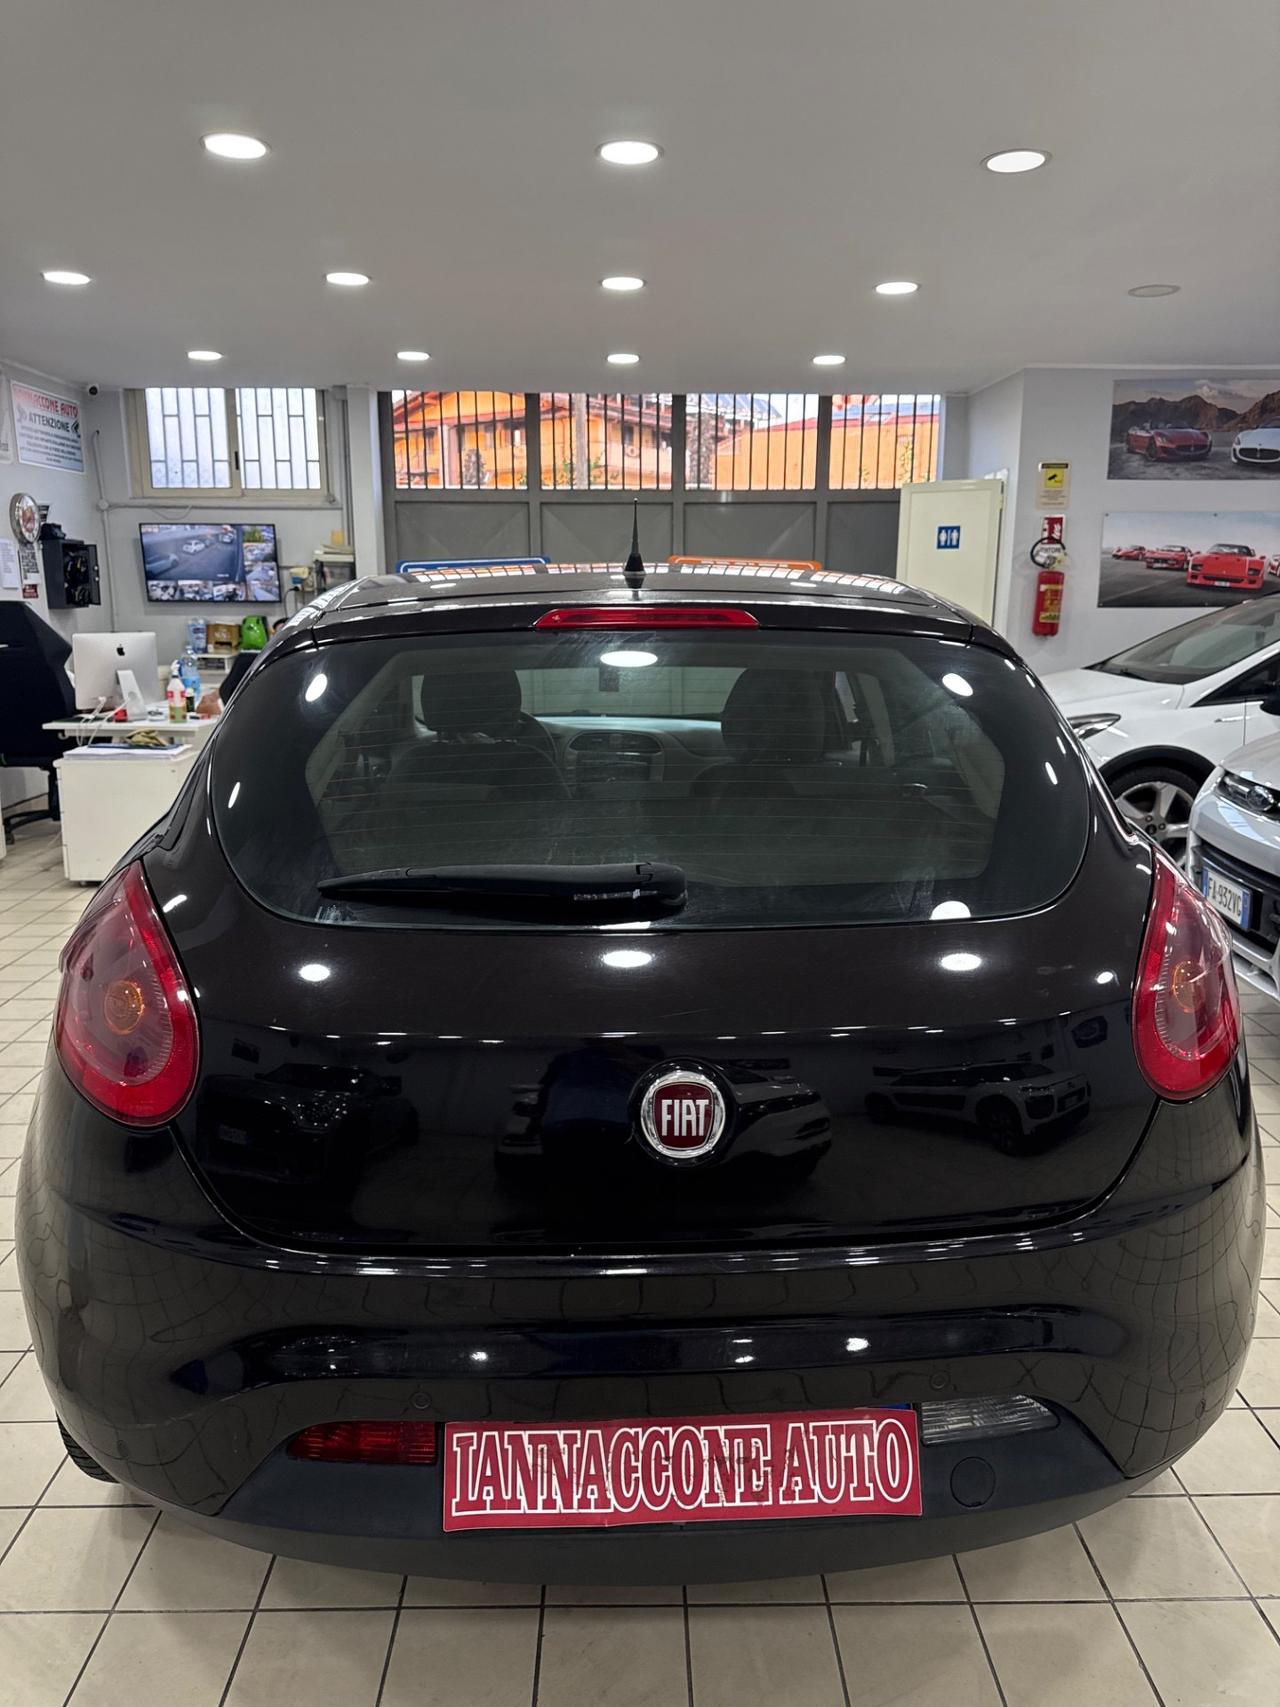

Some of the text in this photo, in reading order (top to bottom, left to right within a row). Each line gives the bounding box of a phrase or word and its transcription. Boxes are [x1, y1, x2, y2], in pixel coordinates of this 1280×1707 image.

[29, 412, 70, 432] ATTENZIONE
[661, 1099, 709, 1136] FIAT
[452, 1418, 913, 1516] IANNACCONE AUTO
